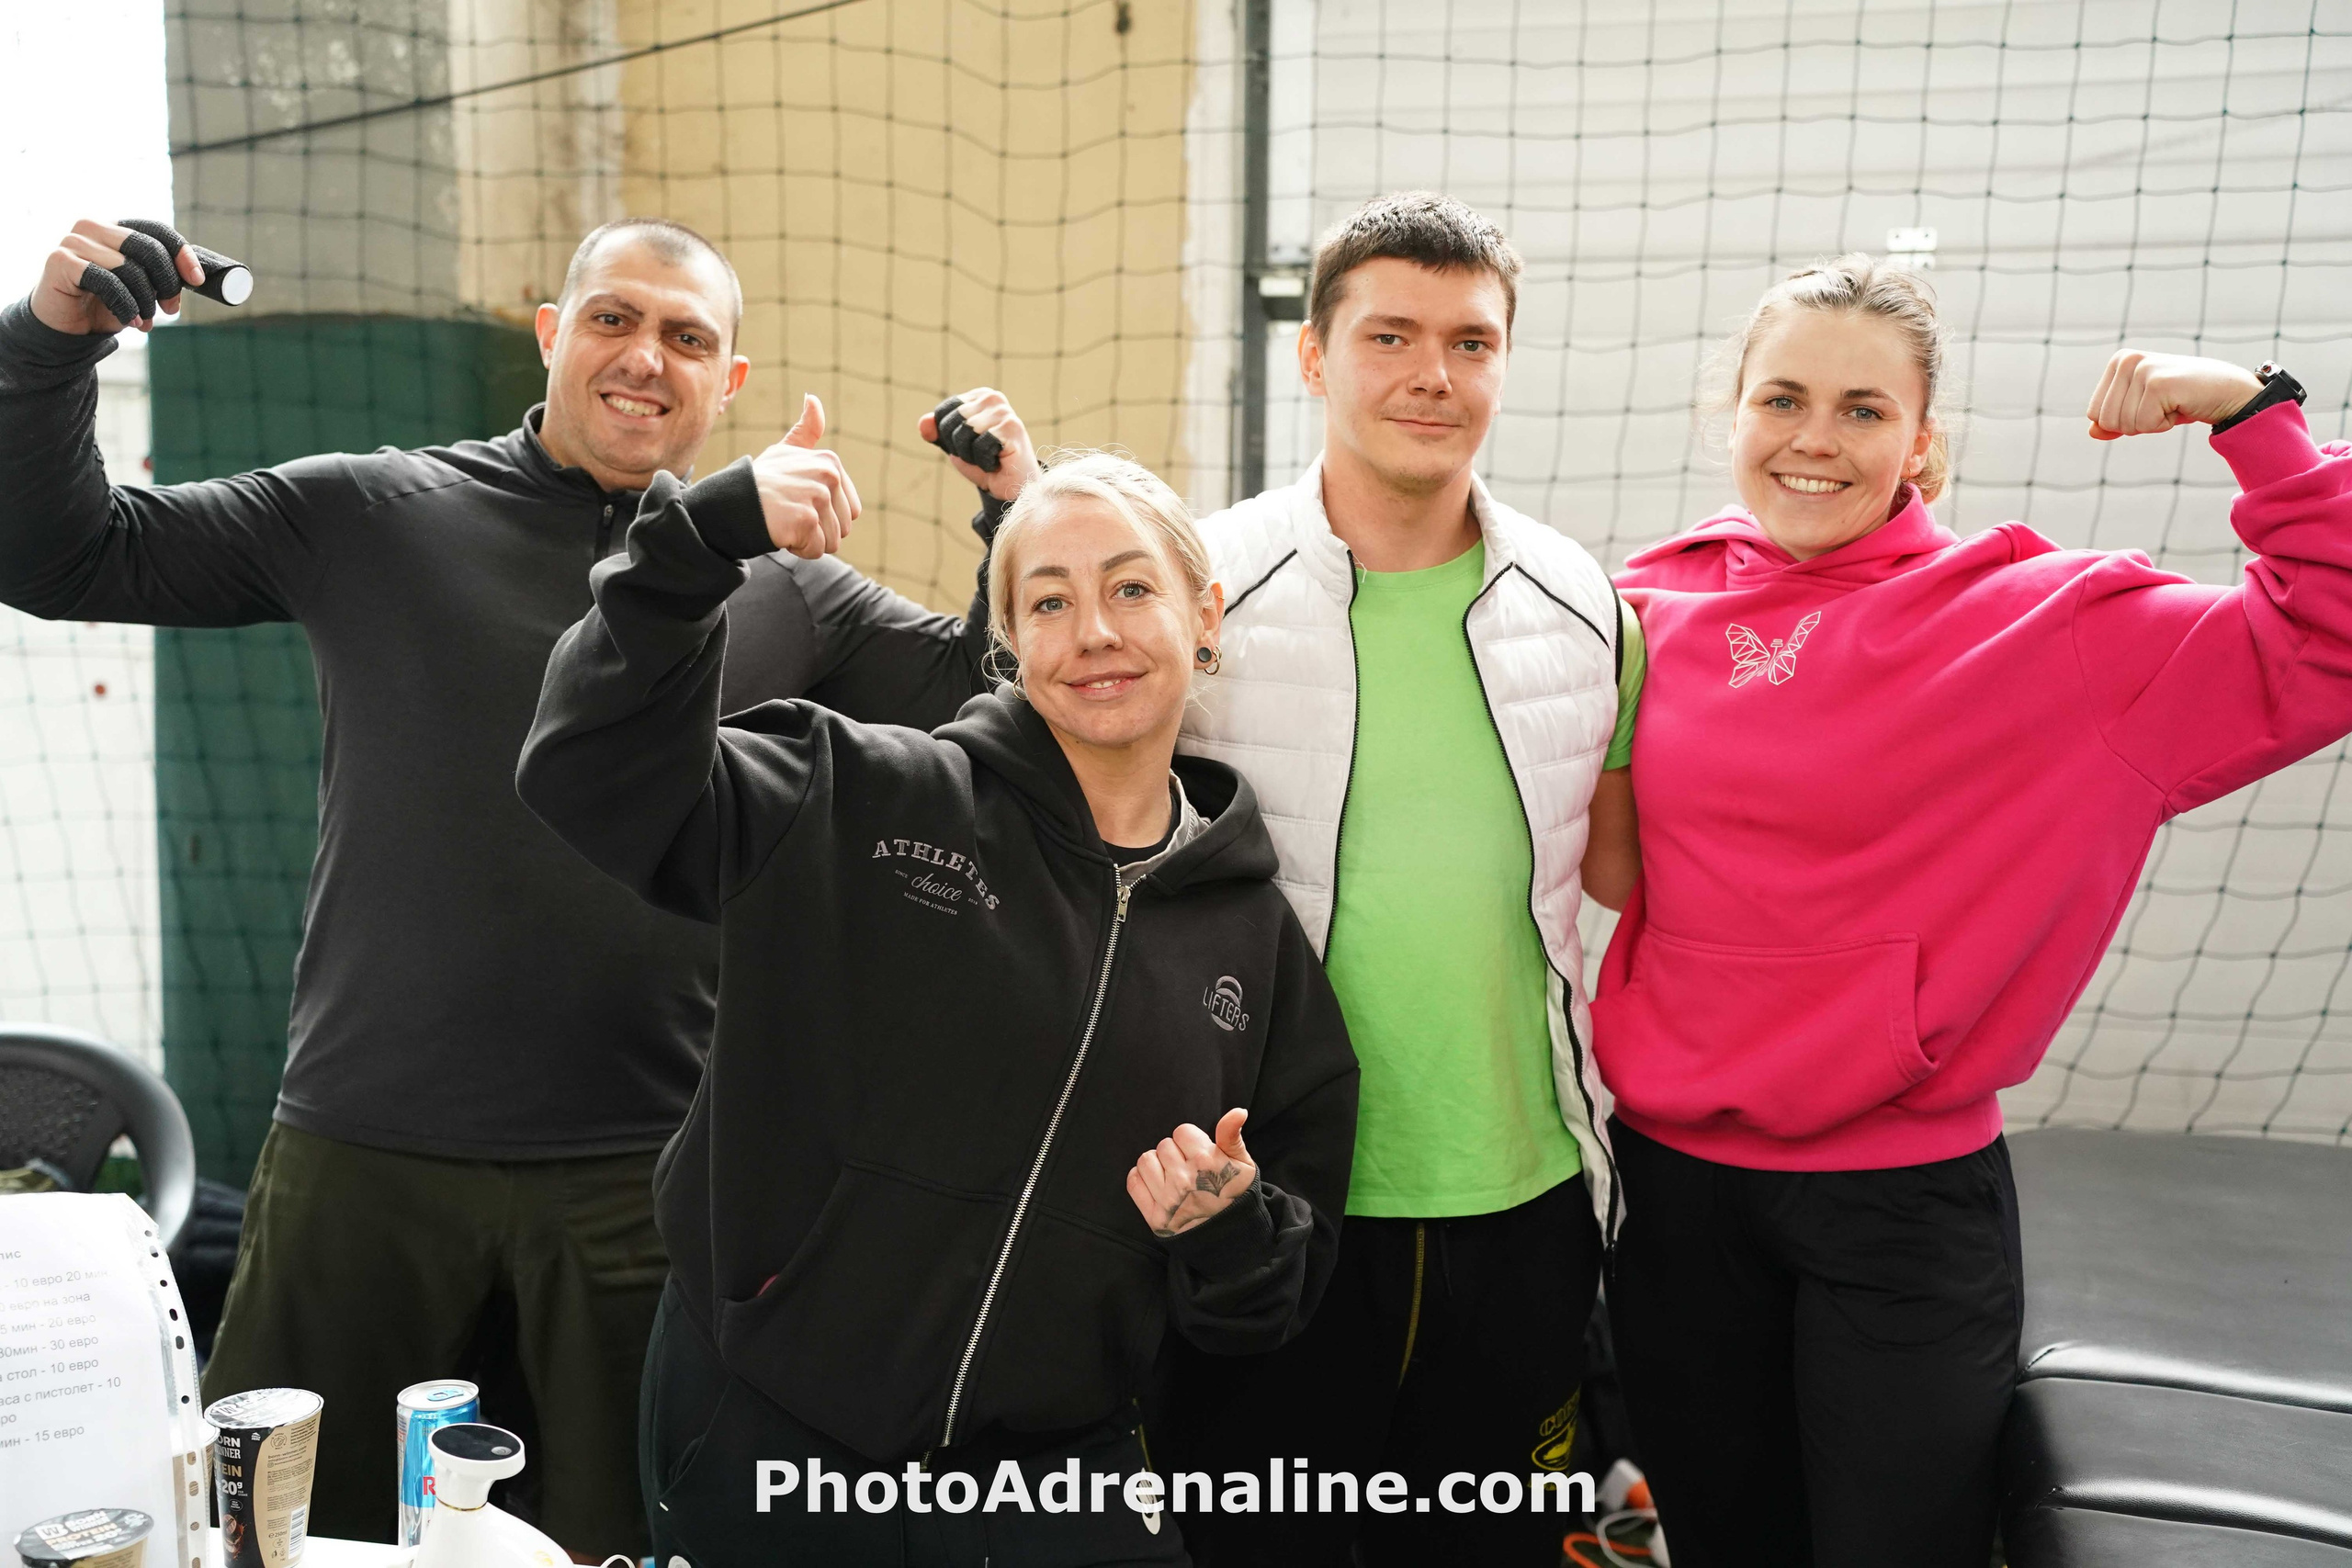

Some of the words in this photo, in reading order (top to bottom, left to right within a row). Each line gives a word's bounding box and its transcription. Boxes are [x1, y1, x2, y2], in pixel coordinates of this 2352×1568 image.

[872, 839, 1001, 910] ATHLETES
[894, 869, 909, 879] SINCE
[910, 873, 963, 901] choice
[903, 891, 919, 902] MADE
[930, 902, 958, 916] ATHLETES
[1203, 987, 1250, 1031] LIFTERS
[14, 1278, 28, 1289] 10
[32, 1275, 62, 1287] евро
[65, 1270, 82, 1282] 20
[9, 1300, 40, 1312] евро
[43, 1298, 58, 1306] на
[62, 1292, 91, 1304] зона
[11, 1323, 37, 1333] мин
[48, 1316, 63, 1328] 20
[67, 1314, 96, 1326] евро
[50, 1338, 65, 1350] 30
[69, 1337, 99, 1348] евро
[6, 1368, 37, 1382] стол
[51, 1361, 65, 1374] 10
[69, 1359, 99, 1371] евро
[24, 1393, 31, 1403] с
[35, 1382, 95, 1401] пистолет
[107, 1376, 121, 1389] 10
[0, 1414, 17, 1427] ро
[35, 1429, 51, 1442] 15
[53, 1426, 85, 1439] евро
